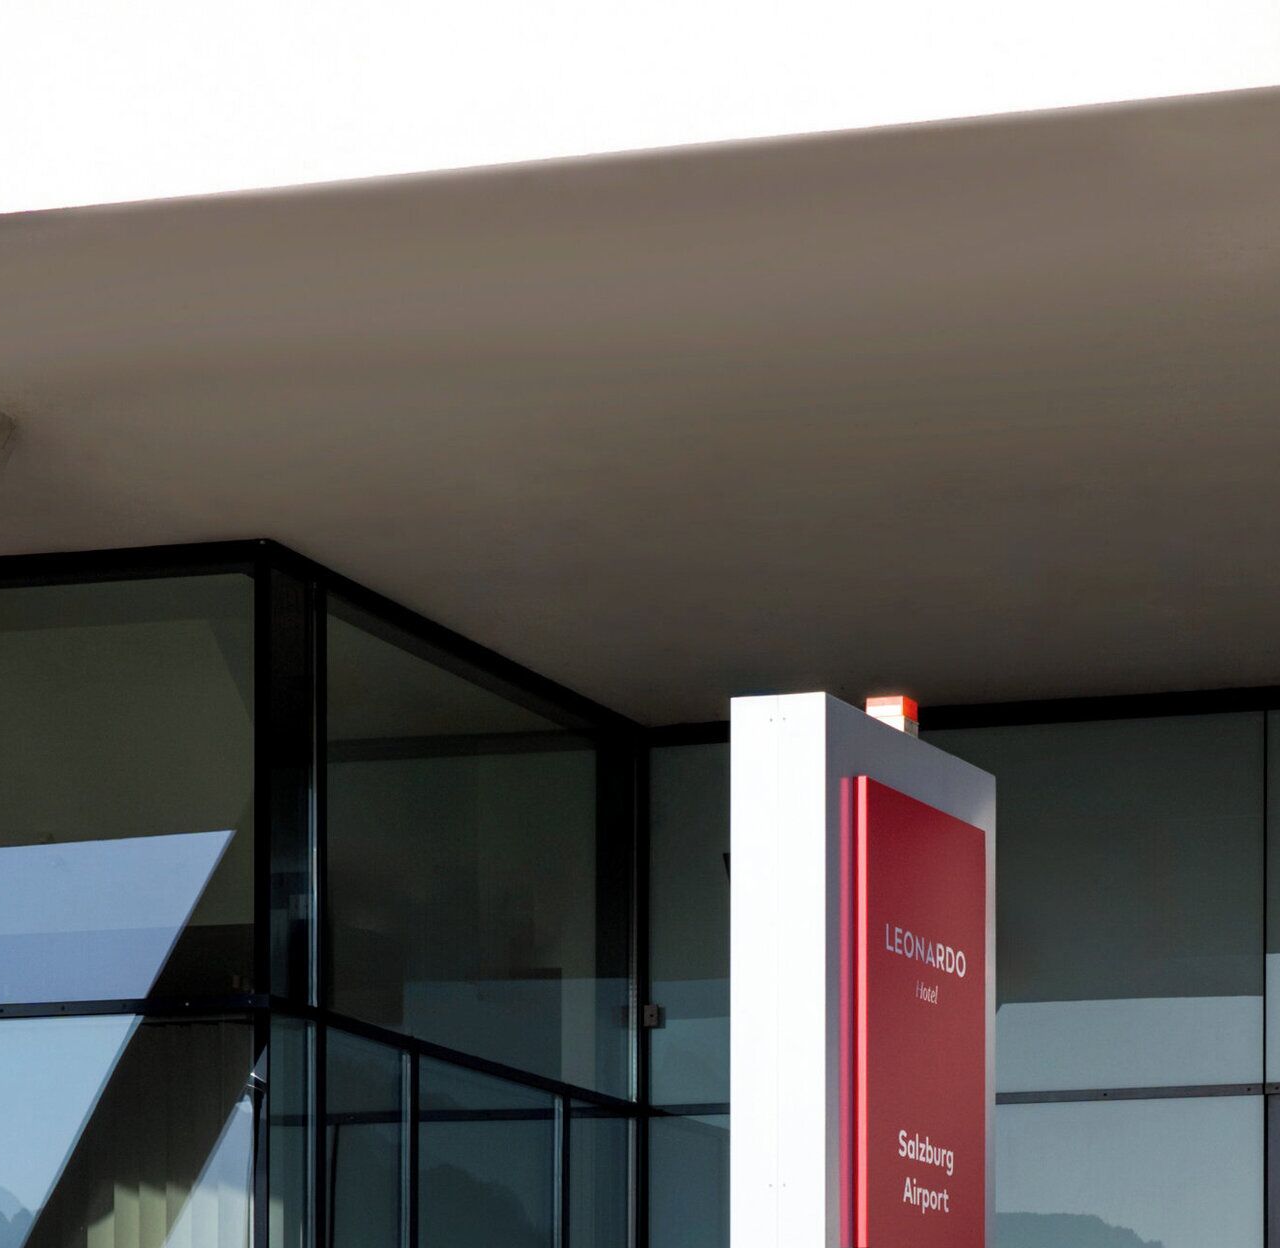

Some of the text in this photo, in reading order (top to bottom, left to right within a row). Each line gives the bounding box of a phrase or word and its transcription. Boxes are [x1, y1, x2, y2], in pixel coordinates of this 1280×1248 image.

[886, 923, 967, 978] LEONARDO
[916, 980, 939, 1005] Hotel
[898, 1129, 954, 1176] Salzburg
[902, 1176, 950, 1215] Airport
